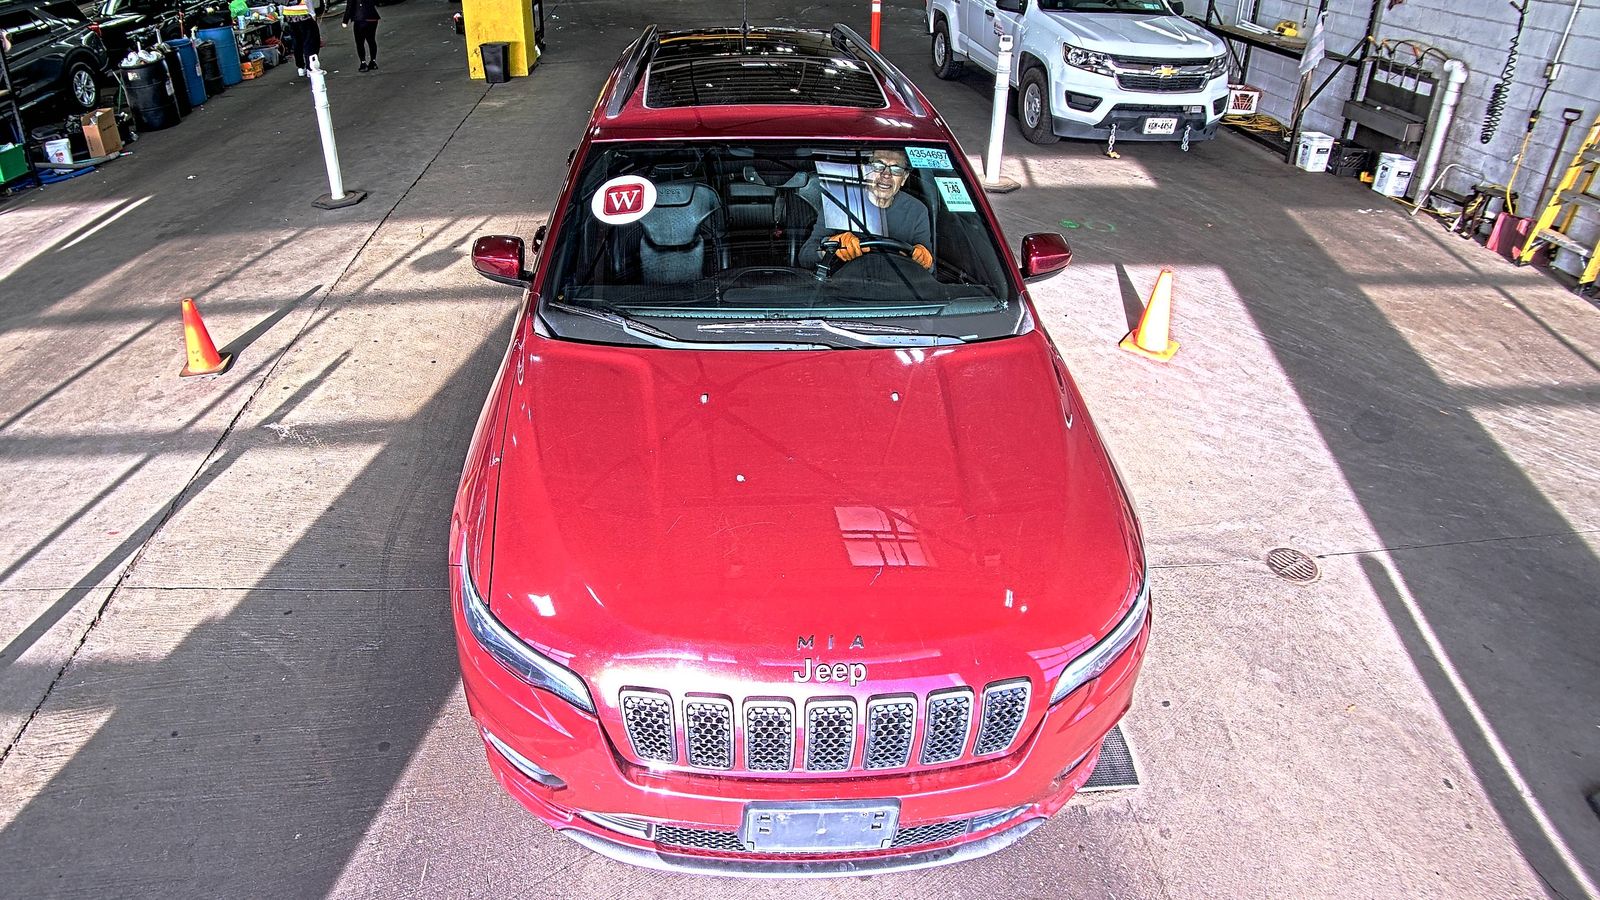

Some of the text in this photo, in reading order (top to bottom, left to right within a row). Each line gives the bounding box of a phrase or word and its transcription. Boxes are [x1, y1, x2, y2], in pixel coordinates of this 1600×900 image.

[909, 149, 948, 160] 4354697
[608, 189, 641, 212] W
[793, 657, 867, 687] Jeep
